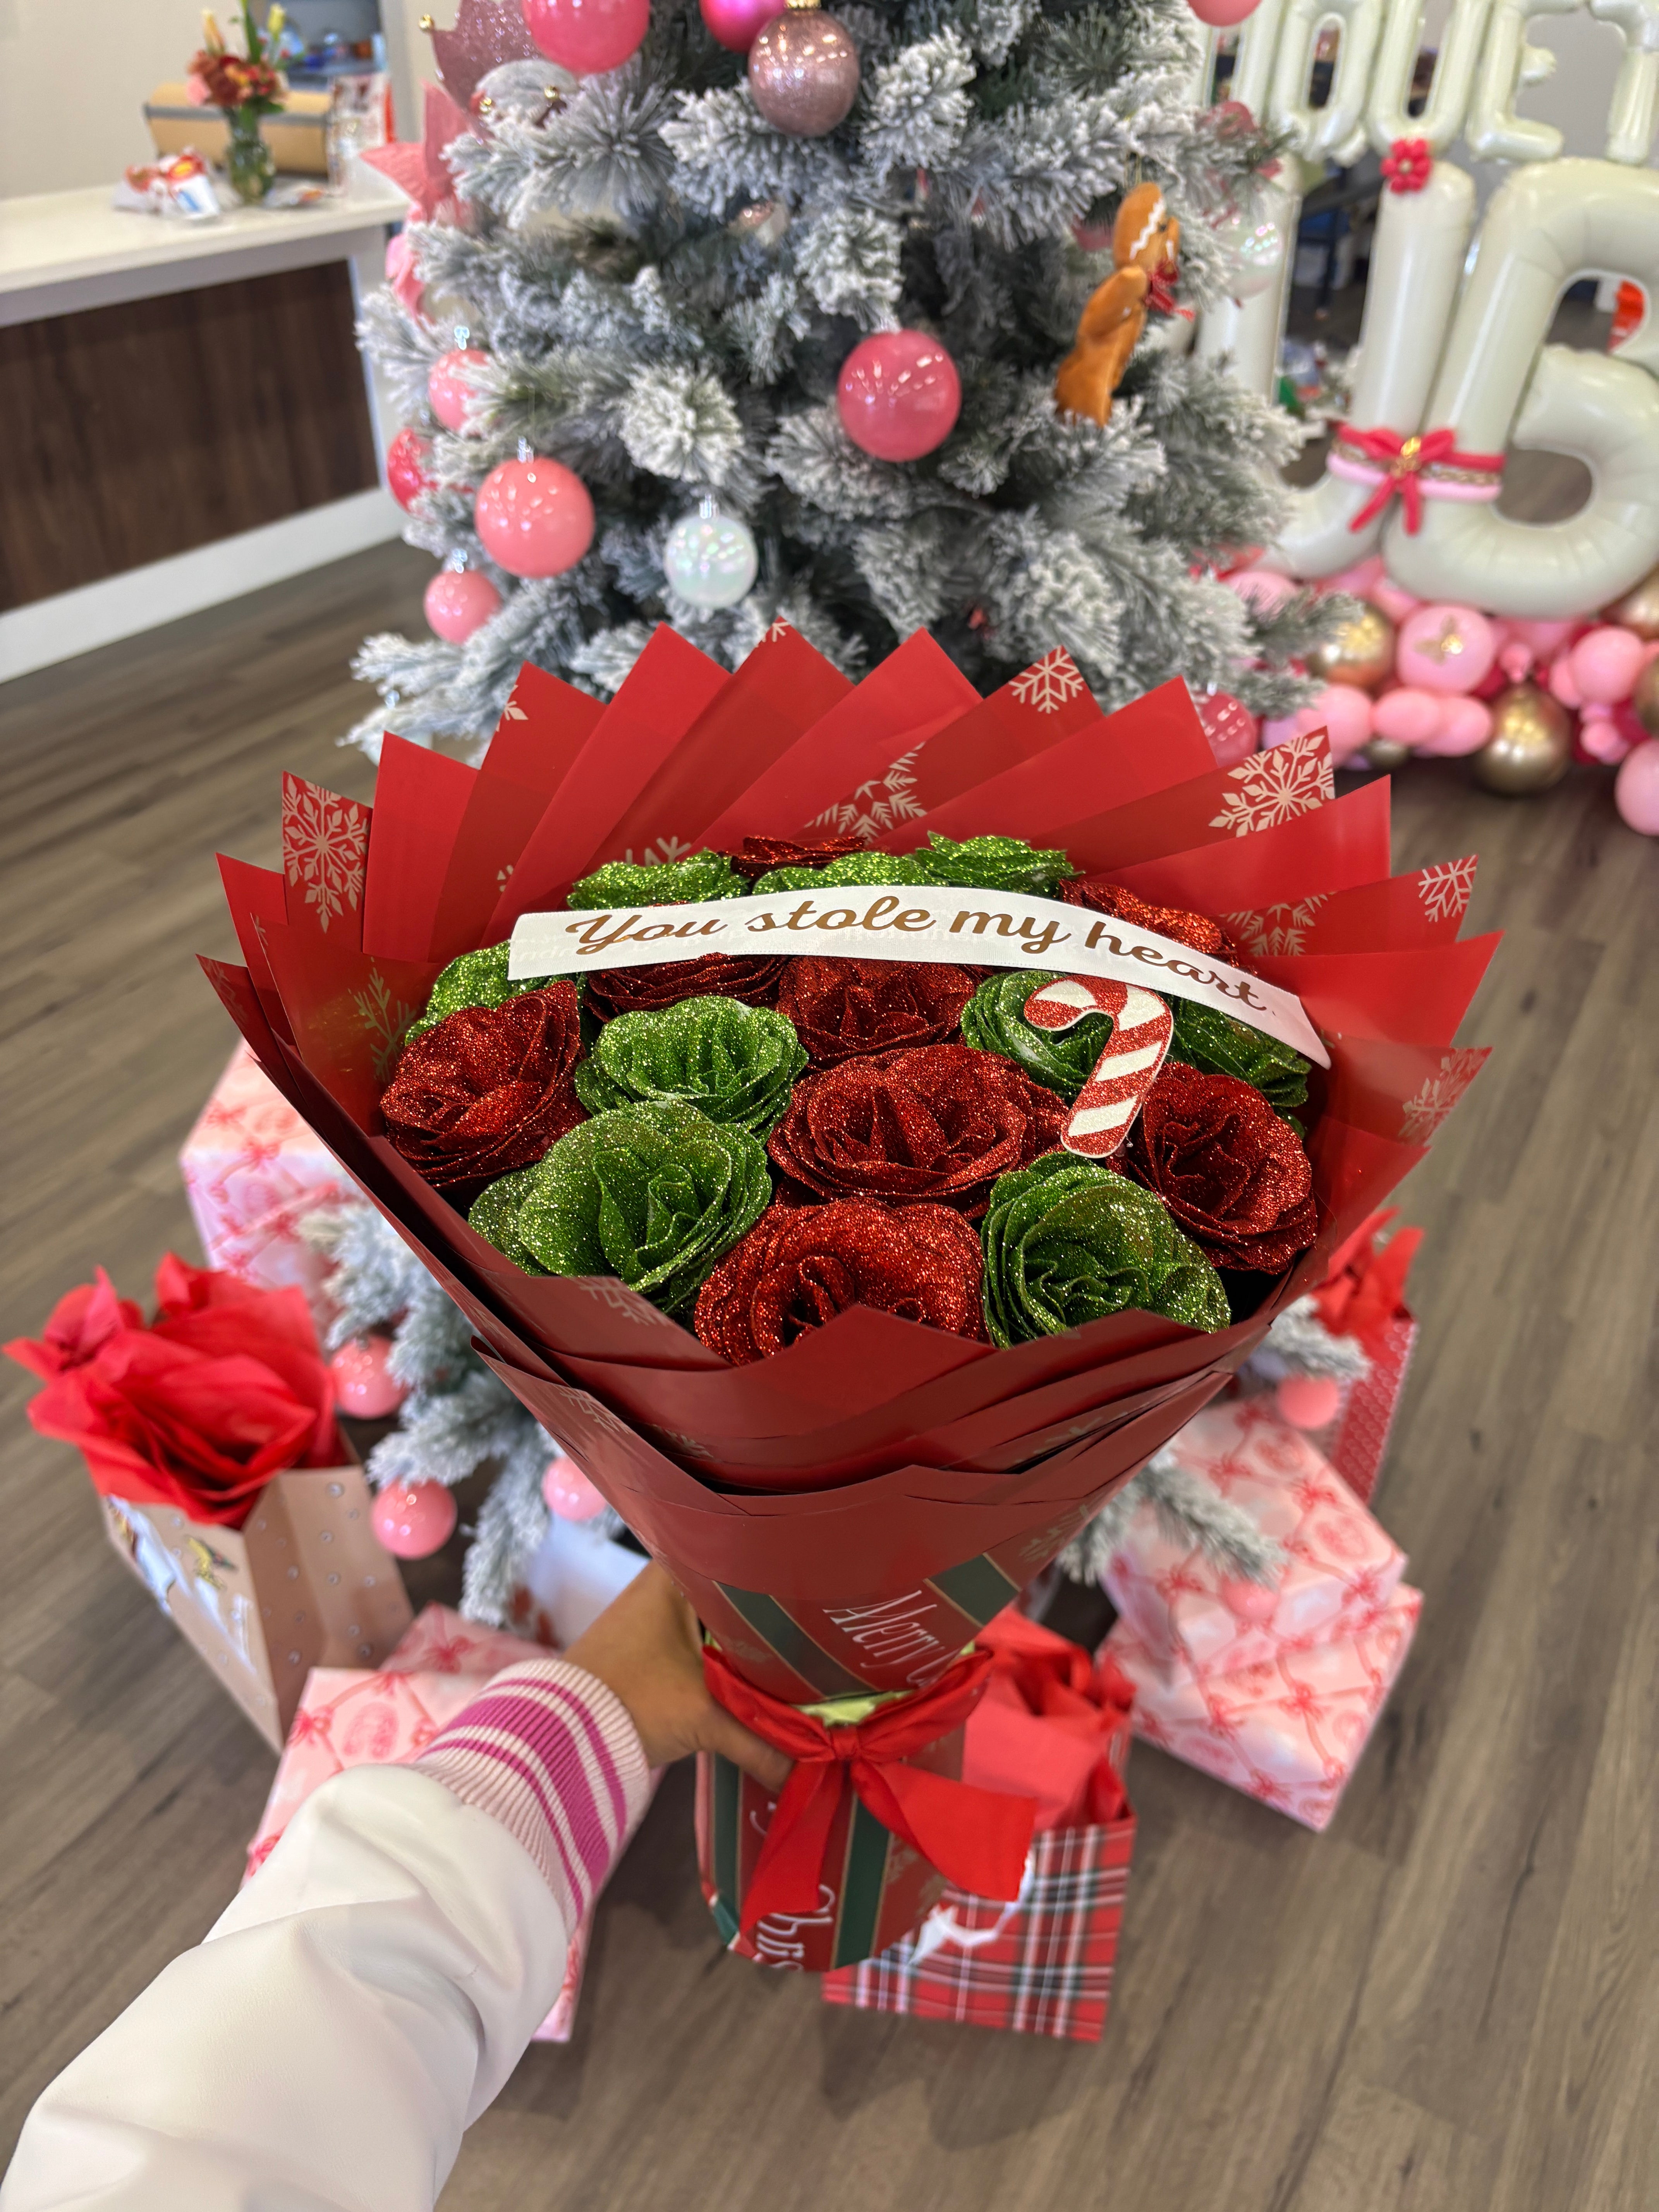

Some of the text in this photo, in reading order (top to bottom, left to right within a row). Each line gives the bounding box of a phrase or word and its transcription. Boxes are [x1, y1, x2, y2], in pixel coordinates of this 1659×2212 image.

[565, 914, 728, 955] You
[744, 895, 937, 932] stole
[949, 910, 1072, 954] my
[822, 1590, 946, 1668] Merry
